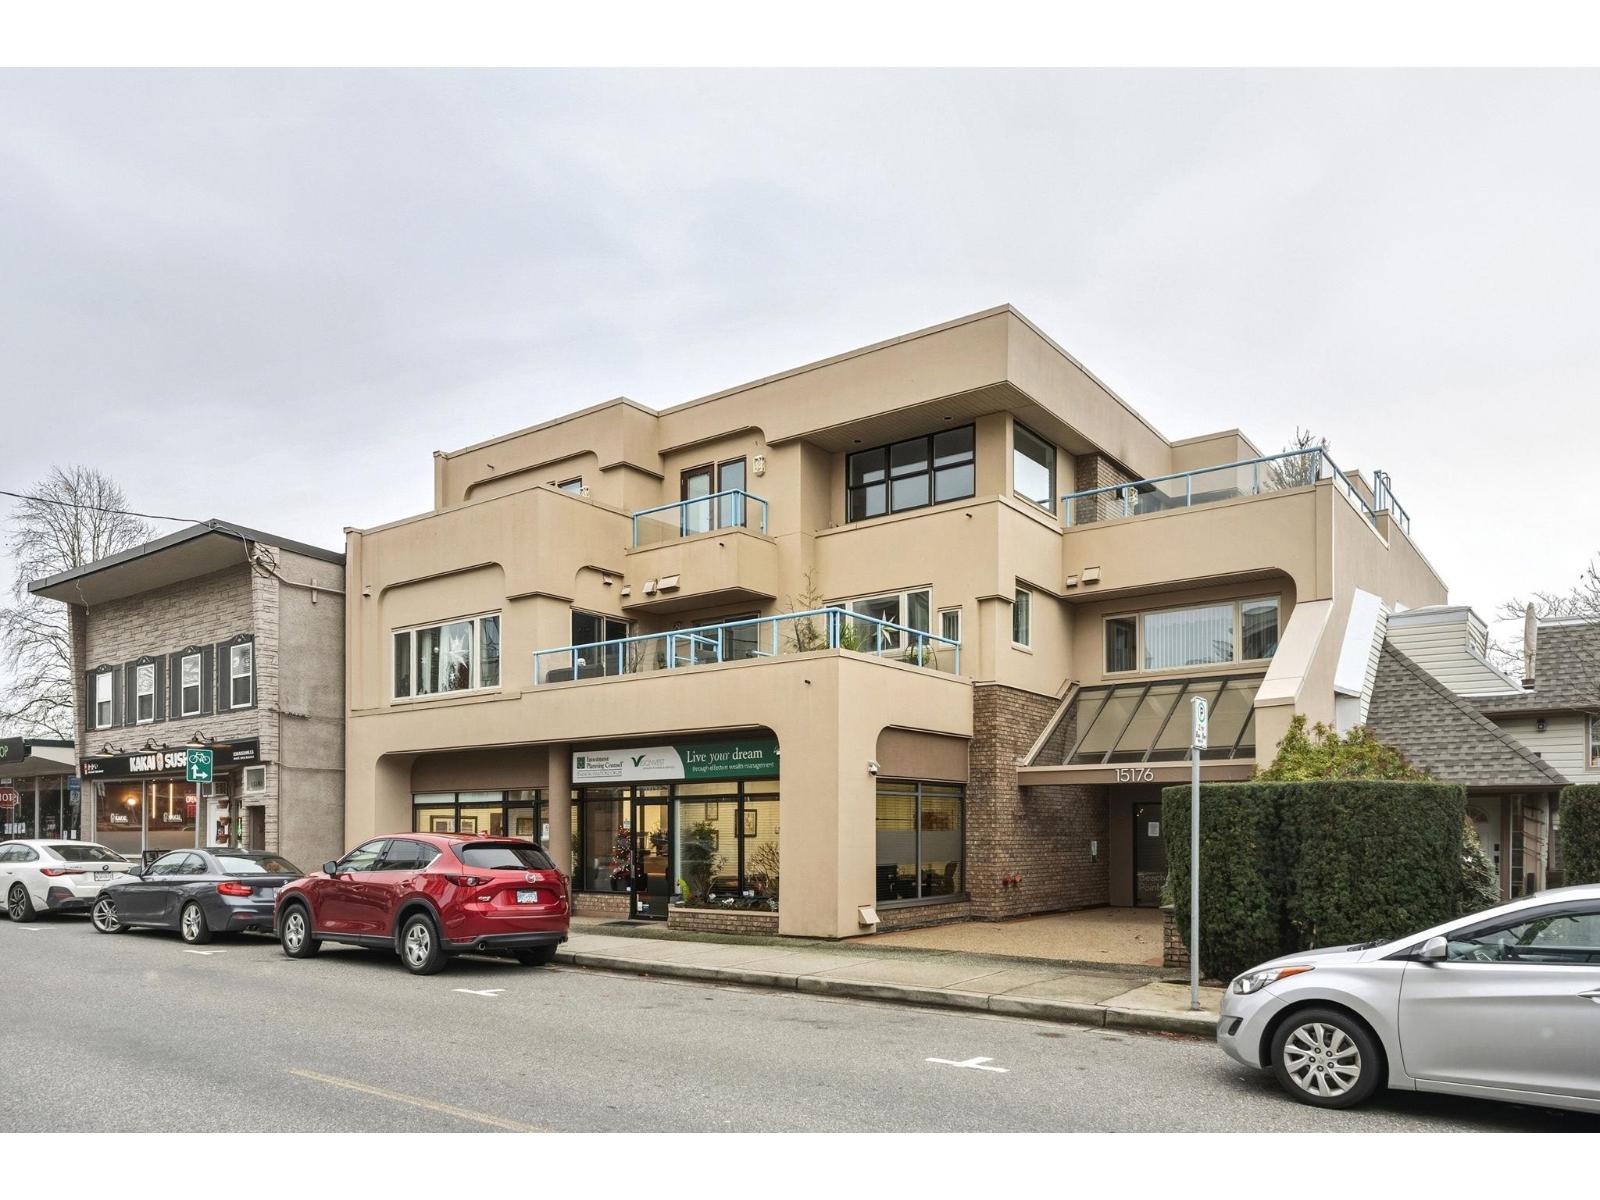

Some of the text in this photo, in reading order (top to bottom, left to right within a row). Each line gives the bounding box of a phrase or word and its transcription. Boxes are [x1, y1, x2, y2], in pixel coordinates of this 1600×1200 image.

[129, 751, 188, 772] KAKAI SUSH
[686, 747, 763, 765] Live your dream
[1115, 767, 1154, 783] 15176
